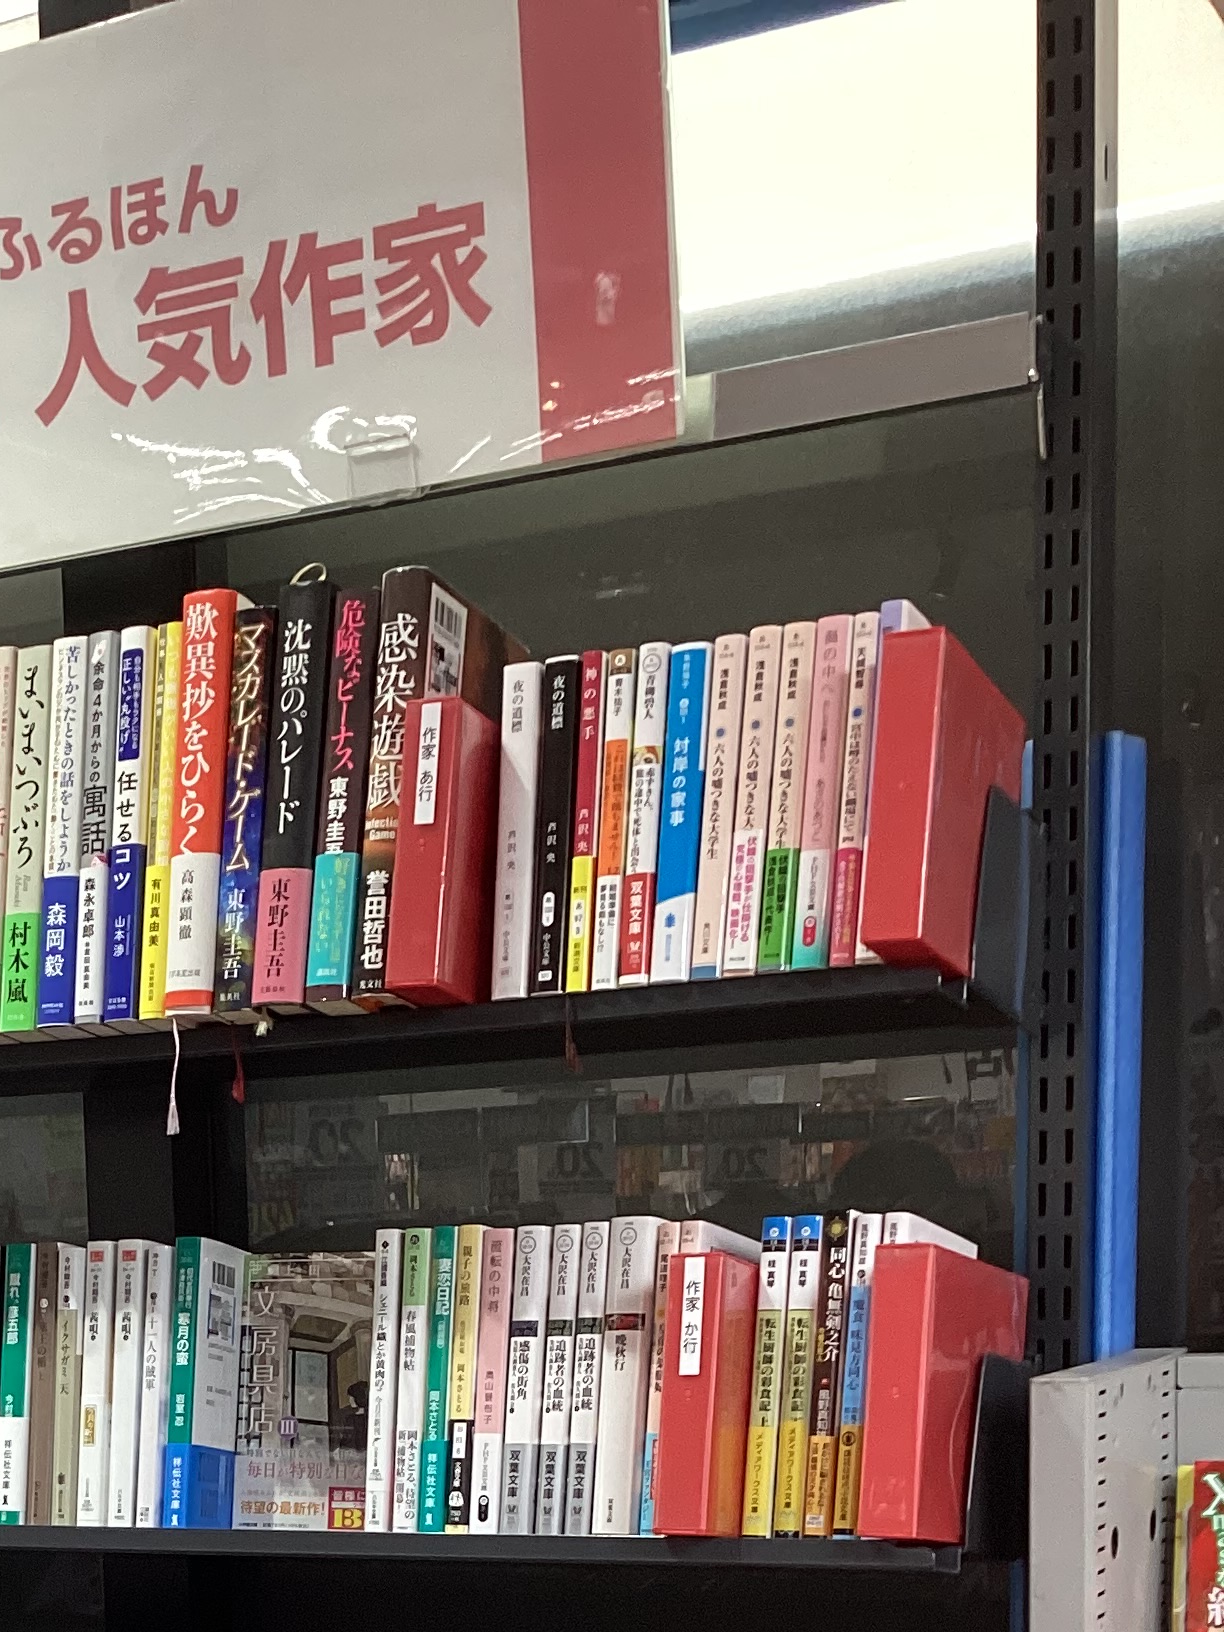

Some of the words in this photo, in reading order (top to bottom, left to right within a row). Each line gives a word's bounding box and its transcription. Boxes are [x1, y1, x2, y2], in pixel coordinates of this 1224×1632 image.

[34, 202, 492, 425] 人気作家
[329, 599, 366, 772] 危険なビーナス
[368, 612, 420, 813] 感染遊戯
[511, 679, 524, 733] 夜の道標
[551, 674, 566, 730] 夜の道標
[583, 667, 598, 741] 神の悪手
[56, 645, 81, 872] 苦しかったときの話をしようか
[179, 603, 218, 854] 歎異抄をひらく
[227, 622, 267, 871] マスカレード・ゲーム
[276, 620, 313, 835] 沈黙のパレード
[421, 727, 435, 759] 作家
[11, 665, 44, 869] まいまいつぶろ
[419, 770, 434, 802] あ行
[669, 736, 690, 827] 対岸の家事
[707, 743, 724, 860] 六人の嘘つきな大学生
[112, 771, 138, 891] 任せるコツ
[577, 808, 589, 853] 芦沢央
[44, 902, 66, 978] 森岡毅
[82, 876, 95, 939] 森永卓郎
[147, 878, 162, 948] 有川真由美
[221, 888, 246, 980] 東野圭吾
[263, 878, 291, 979] 東野圭吾
[360, 870, 389, 970] 誉田哲也
[6, 922, 30, 1003] 村木嵐
[436, 1257, 453, 1316] 妻恋日記
[459, 1244, 474, 1306] 親子の旅路
[520, 1253, 532, 1297] 大沢在昌
[556, 1253, 568, 1296] 大沢在昌
[586, 1251, 598, 1296] 大沢在昌
[620, 1246, 632, 1290] 大沢在昌
[685, 1280, 702, 1312] 作家
[144, 1317, 158, 1391] 十一人の賊軍
[403, 1310, 416, 1372] 春風捕物帖
[516, 1340, 530, 1401] 感傷の街角
[682, 1322, 699, 1355] か行
[551, 1340, 566, 1412] 追跡者の血統
[580, 1337, 596, 1412] 追跡者の血統
[507, 1450, 521, 1498] 双葉文庫
[544, 1451, 556, 1499] 双葉文庫
[572, 1450, 587, 1499] 双葉文庫
